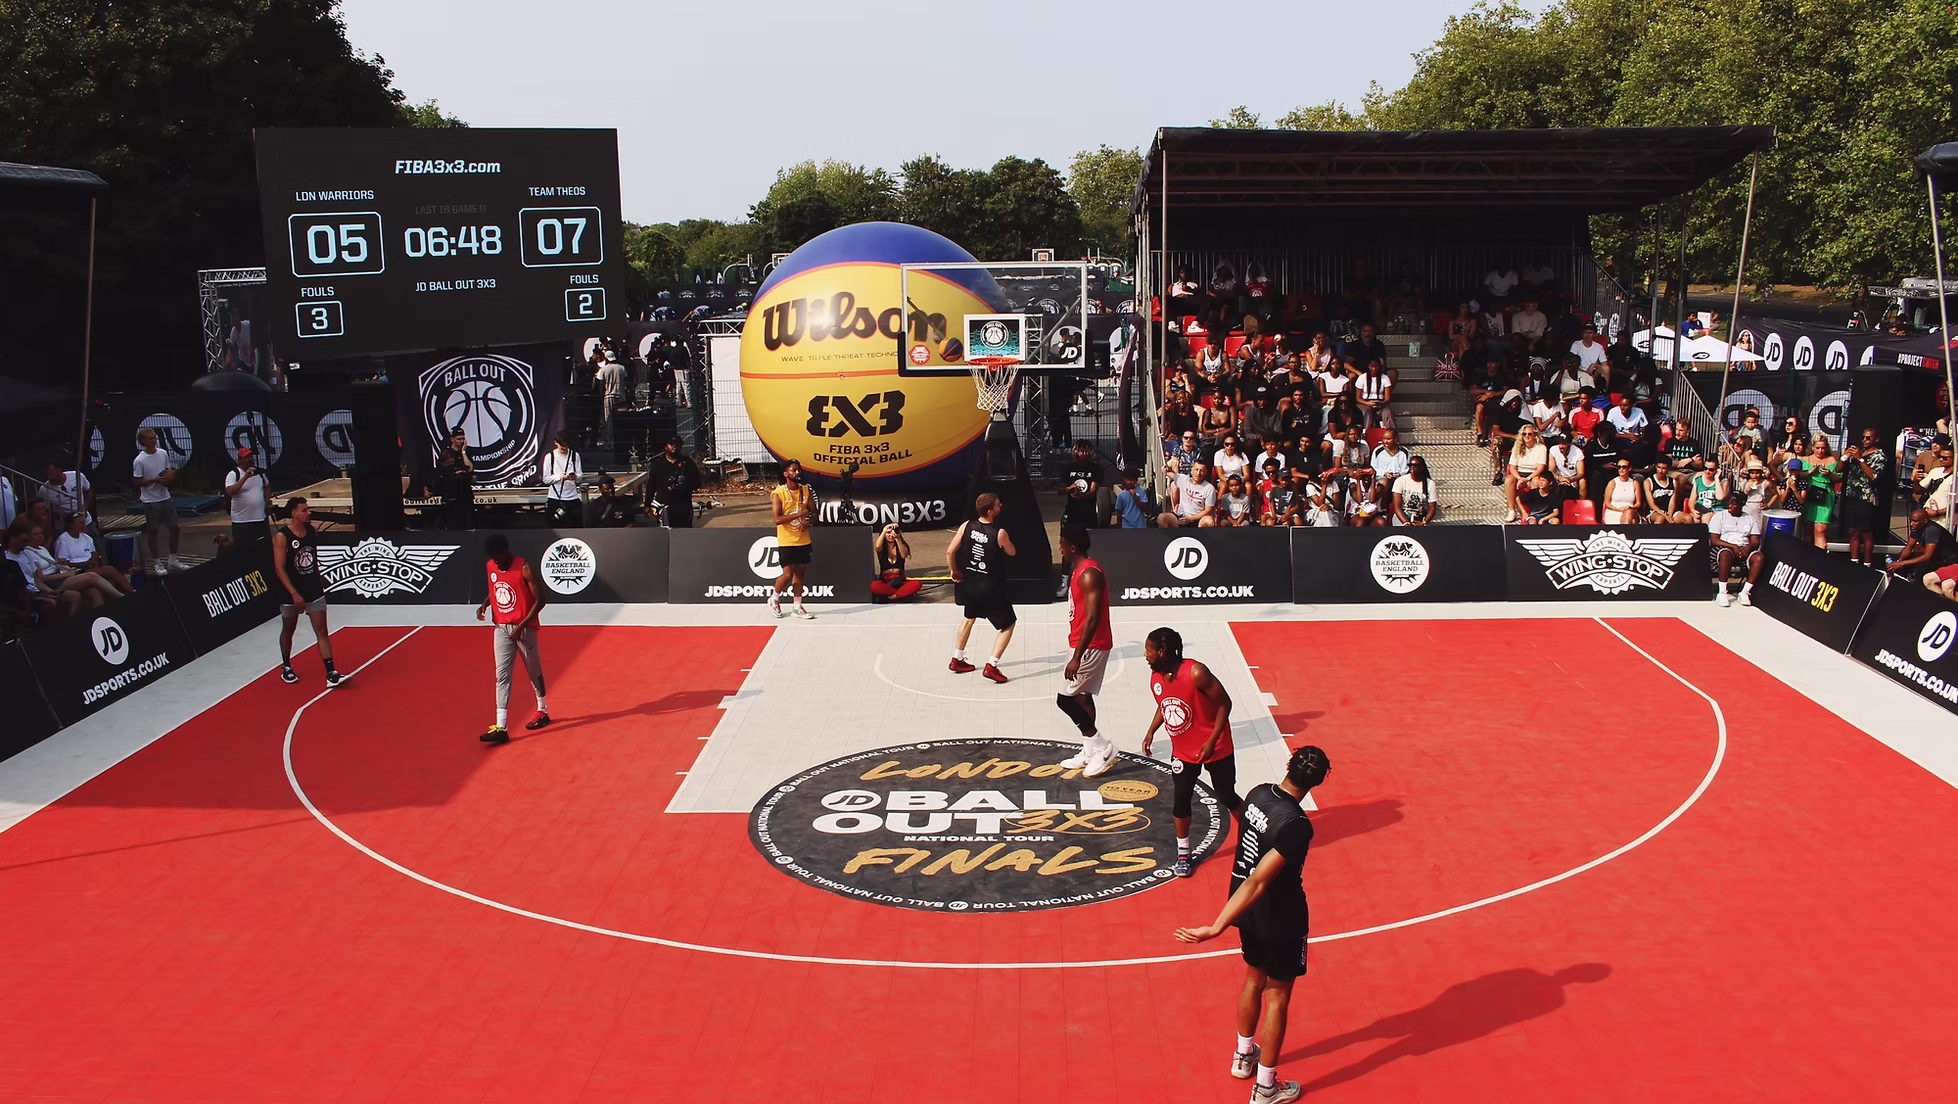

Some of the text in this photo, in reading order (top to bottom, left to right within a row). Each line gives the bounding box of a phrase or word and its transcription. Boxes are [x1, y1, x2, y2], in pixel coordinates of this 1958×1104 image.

[395, 160, 501, 174] FIBA3x3.com
[296, 190, 374, 202] LDN WARRIORS
[529, 186, 586, 196] TEAM THEOS
[415, 205, 437, 215] LAST
[452, 204, 477, 214] GAME
[306, 224, 368, 265] 05
[404, 225, 502, 258] 06:48
[537, 217, 587, 256] 07
[415, 278, 496, 291] JD BALL OUT 3X3
[570, 274, 599, 284] FOULS
[301, 286, 334, 298] FOULS
[579, 293, 593, 315] 2
[312, 308, 328, 330] 3
[762, 291, 947, 351] Wilson
[1060, 346, 1078, 359] JD
[1766, 341, 1780, 362] JD
[1796, 344, 1811, 364] JD
[1829, 350, 1844, 369] JD
[444, 363, 506, 387] BALL OUT
[471, 440, 516, 462] HAMPIONSHIP
[813, 449, 913, 466] OFFICIAL BALL
[829, 442, 890, 455] FIBA 3x3
[511, 464, 537, 486] GRIND
[360, 546, 391, 557] THE WING
[1592, 540, 1626, 551] THE WING
[754, 547, 781, 568] JD
[1170, 547, 1202, 569] JD
[359, 579, 387, 589] EXPERTS
[1595, 574, 1625, 584] EXPERTS
[1768, 561, 1839, 612] BALL OUT 3X3
[202, 570, 268, 618] BALL OUT 3X3
[704, 585, 835, 598] JDSPORT.CO.UK
[1121, 585, 1255, 600] JDSPORTS.CO.UK
[100, 626, 123, 657] JD
[1921, 622, 1951, 650] JD
[82, 652, 170, 705] JDSPORTS.CO.UK
[993, 739, 1053, 747] NATIONAL
[789, 775, 813, 786] BALL
[810, 766, 830, 776] OUT
[828, 750, 884, 769] NATIONAL
[882, 745, 915, 754] TOUR
[1133, 759, 1155, 767] OUT
[828, 790, 1135, 811] JD BALL
[1207, 805, 1220, 818] BALL
[757, 792, 786, 858] BALL OUT NATIONAL TOUR
[812, 812, 1026, 834] OUT
[1210, 818, 1221, 830] OUT
[1191, 829, 1219, 855] NATIONAL
[843, 843, 1157, 876] FINALS
[786, 863, 814, 879] TOUR
[813, 875, 874, 898] NATIONAL
[1098, 886, 1124, 897] OUT
[1123, 876, 1157, 889] BALL
[908, 898, 945, 908] BALL
[1019, 893, 1095, 907] NATIONAL
